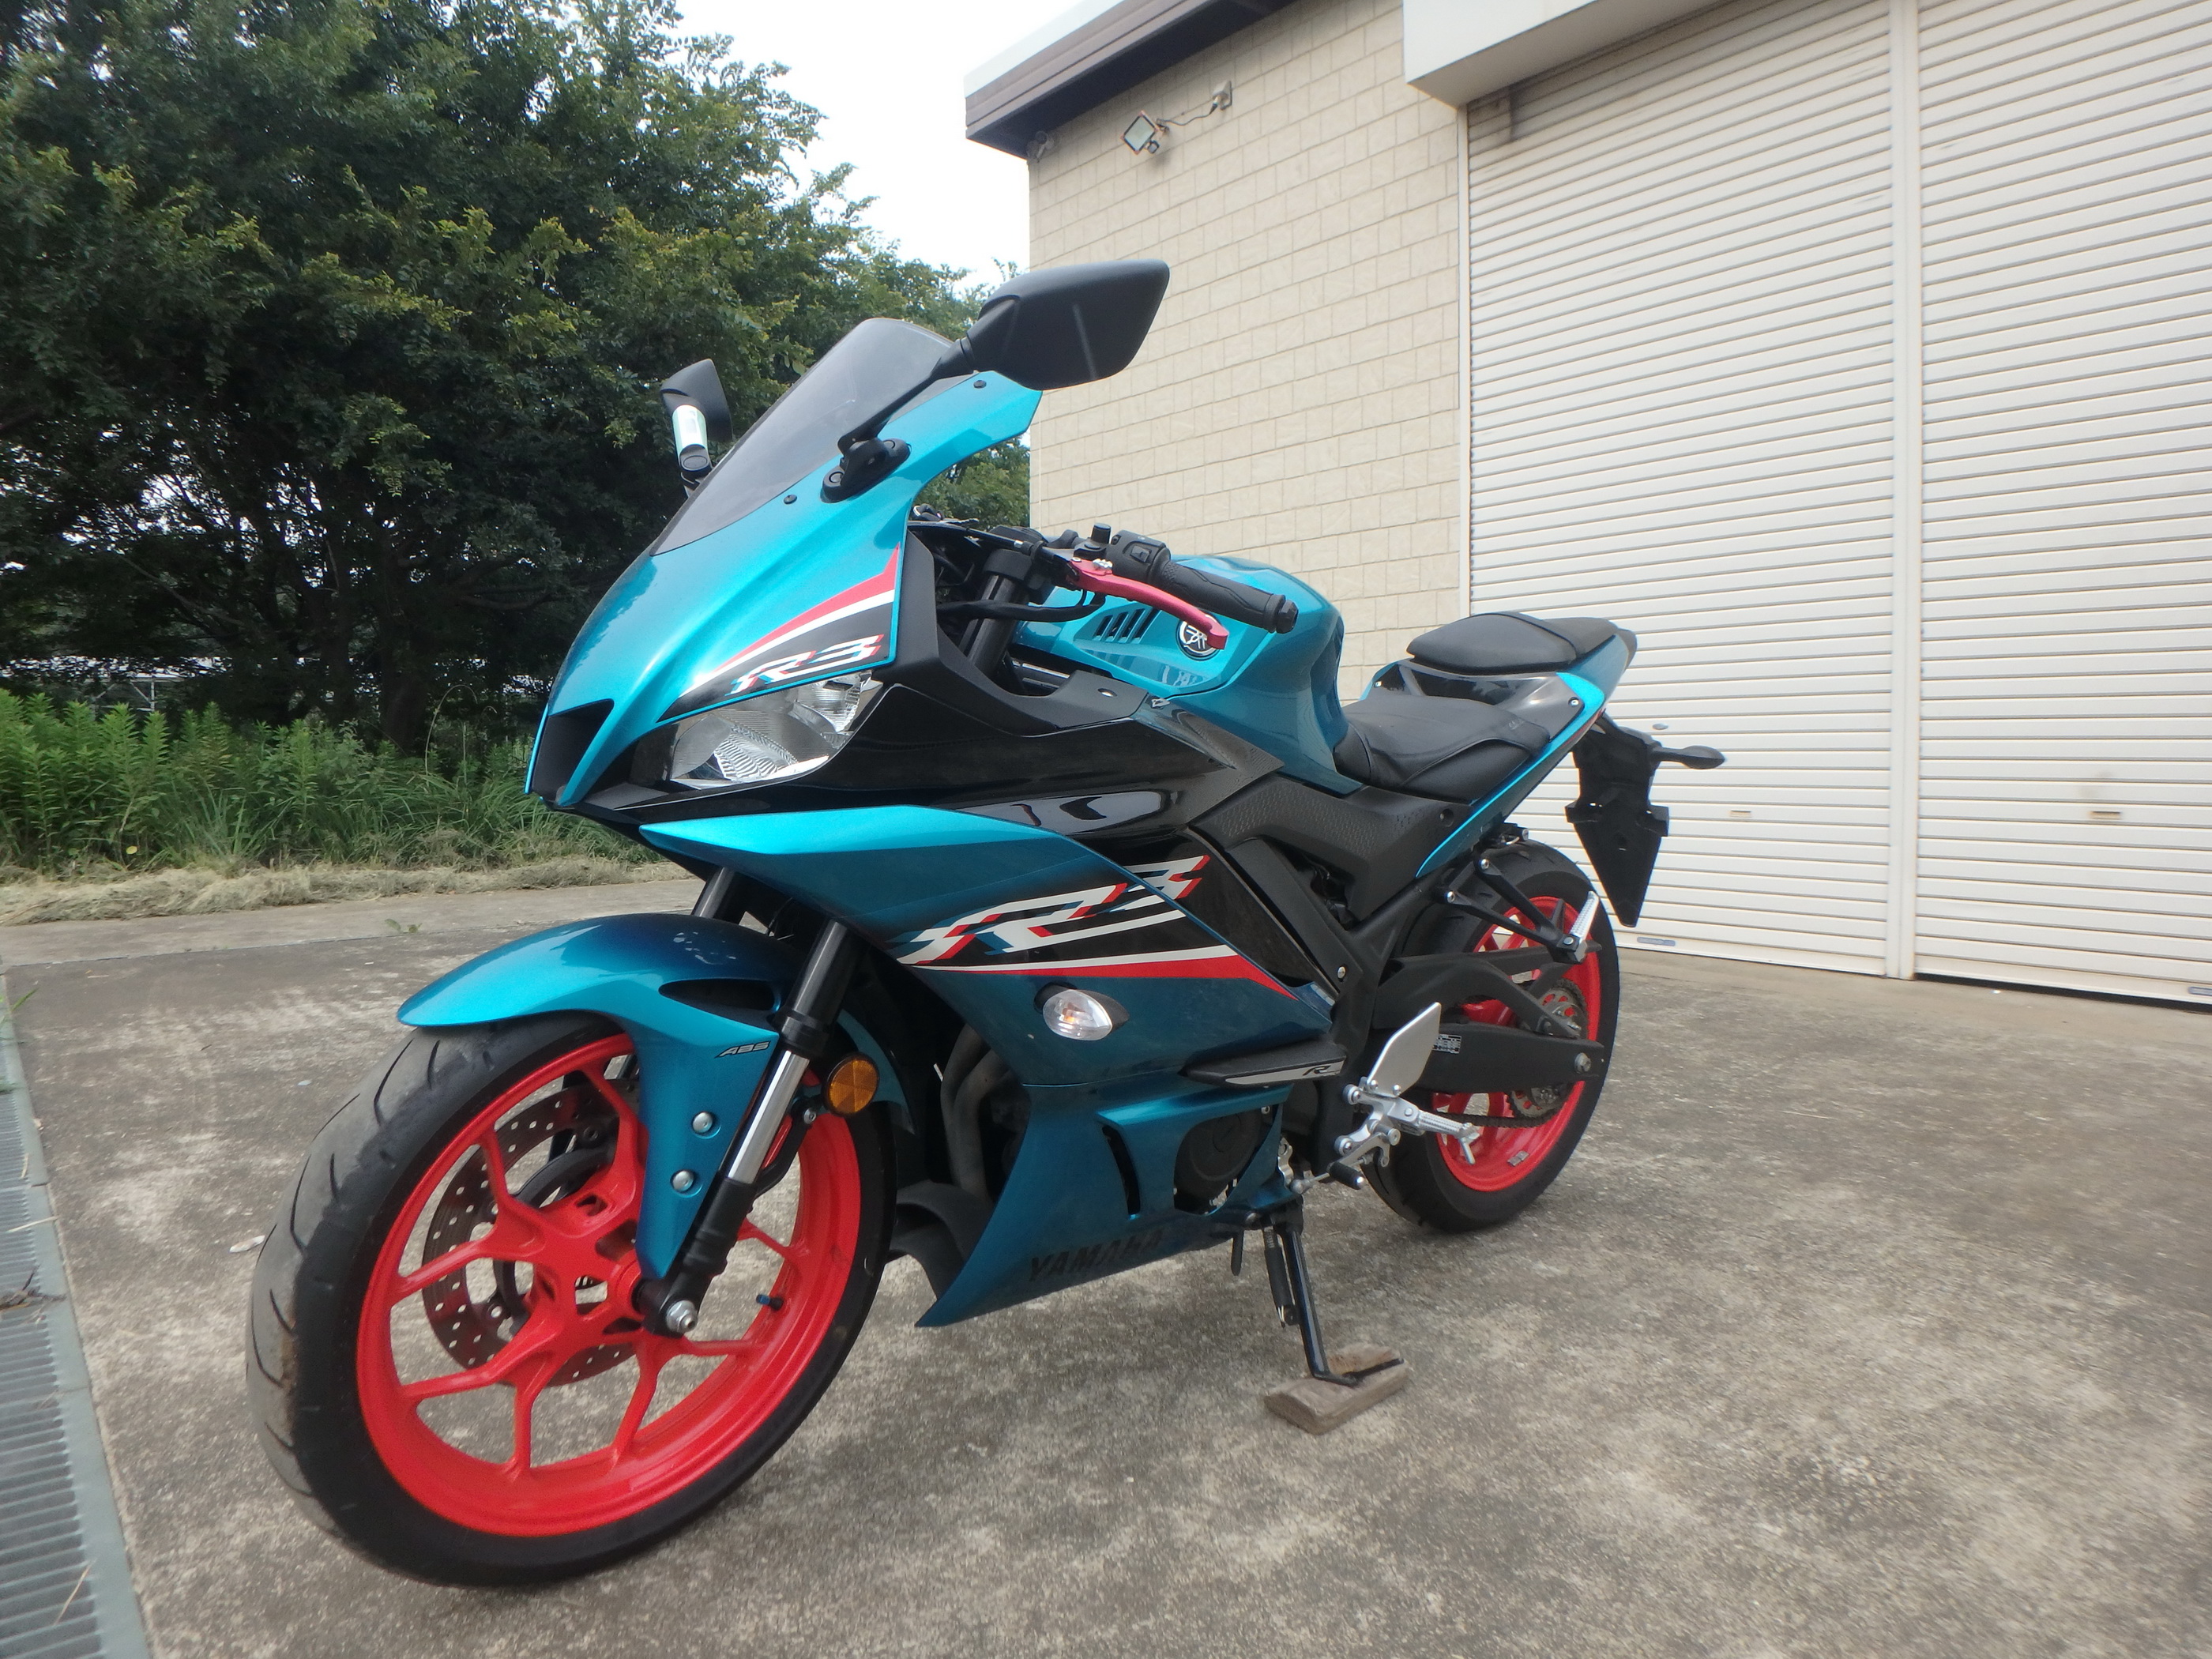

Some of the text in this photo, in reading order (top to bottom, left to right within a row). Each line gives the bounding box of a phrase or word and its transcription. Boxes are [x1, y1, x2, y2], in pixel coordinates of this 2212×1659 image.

[724, 634, 885, 697] R3
[714, 1040, 771, 1059] ABS
[1029, 1228, 1164, 1282] YAMAHA
